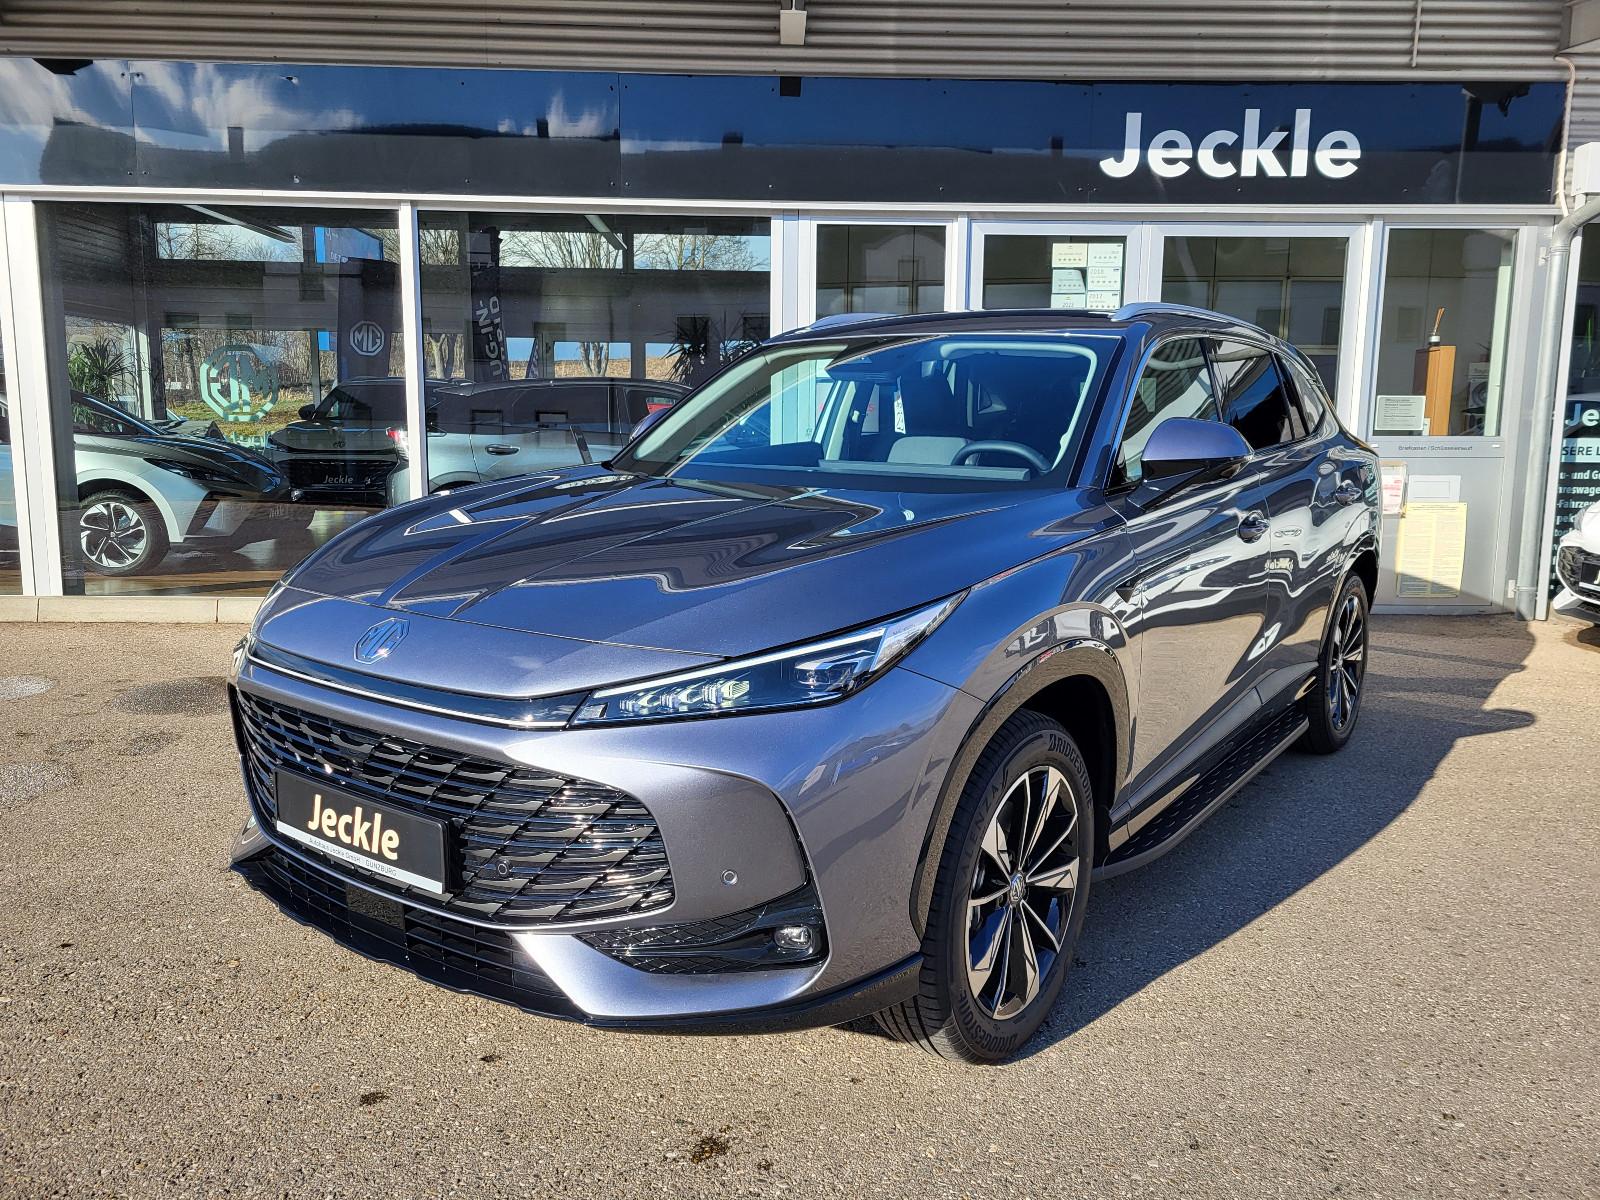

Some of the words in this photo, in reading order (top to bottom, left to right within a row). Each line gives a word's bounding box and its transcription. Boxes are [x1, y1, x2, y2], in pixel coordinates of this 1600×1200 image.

[1099, 108, 1361, 178] Jeckle
[353, 325, 383, 352] MG
[323, 474, 353, 484] Jeckle
[357, 619, 408, 662] MG
[1048, 733, 1092, 809] BRIDGESTONE
[307, 794, 399, 860] Jeckle
[960, 988, 1018, 1054] BRIDGESTONE
